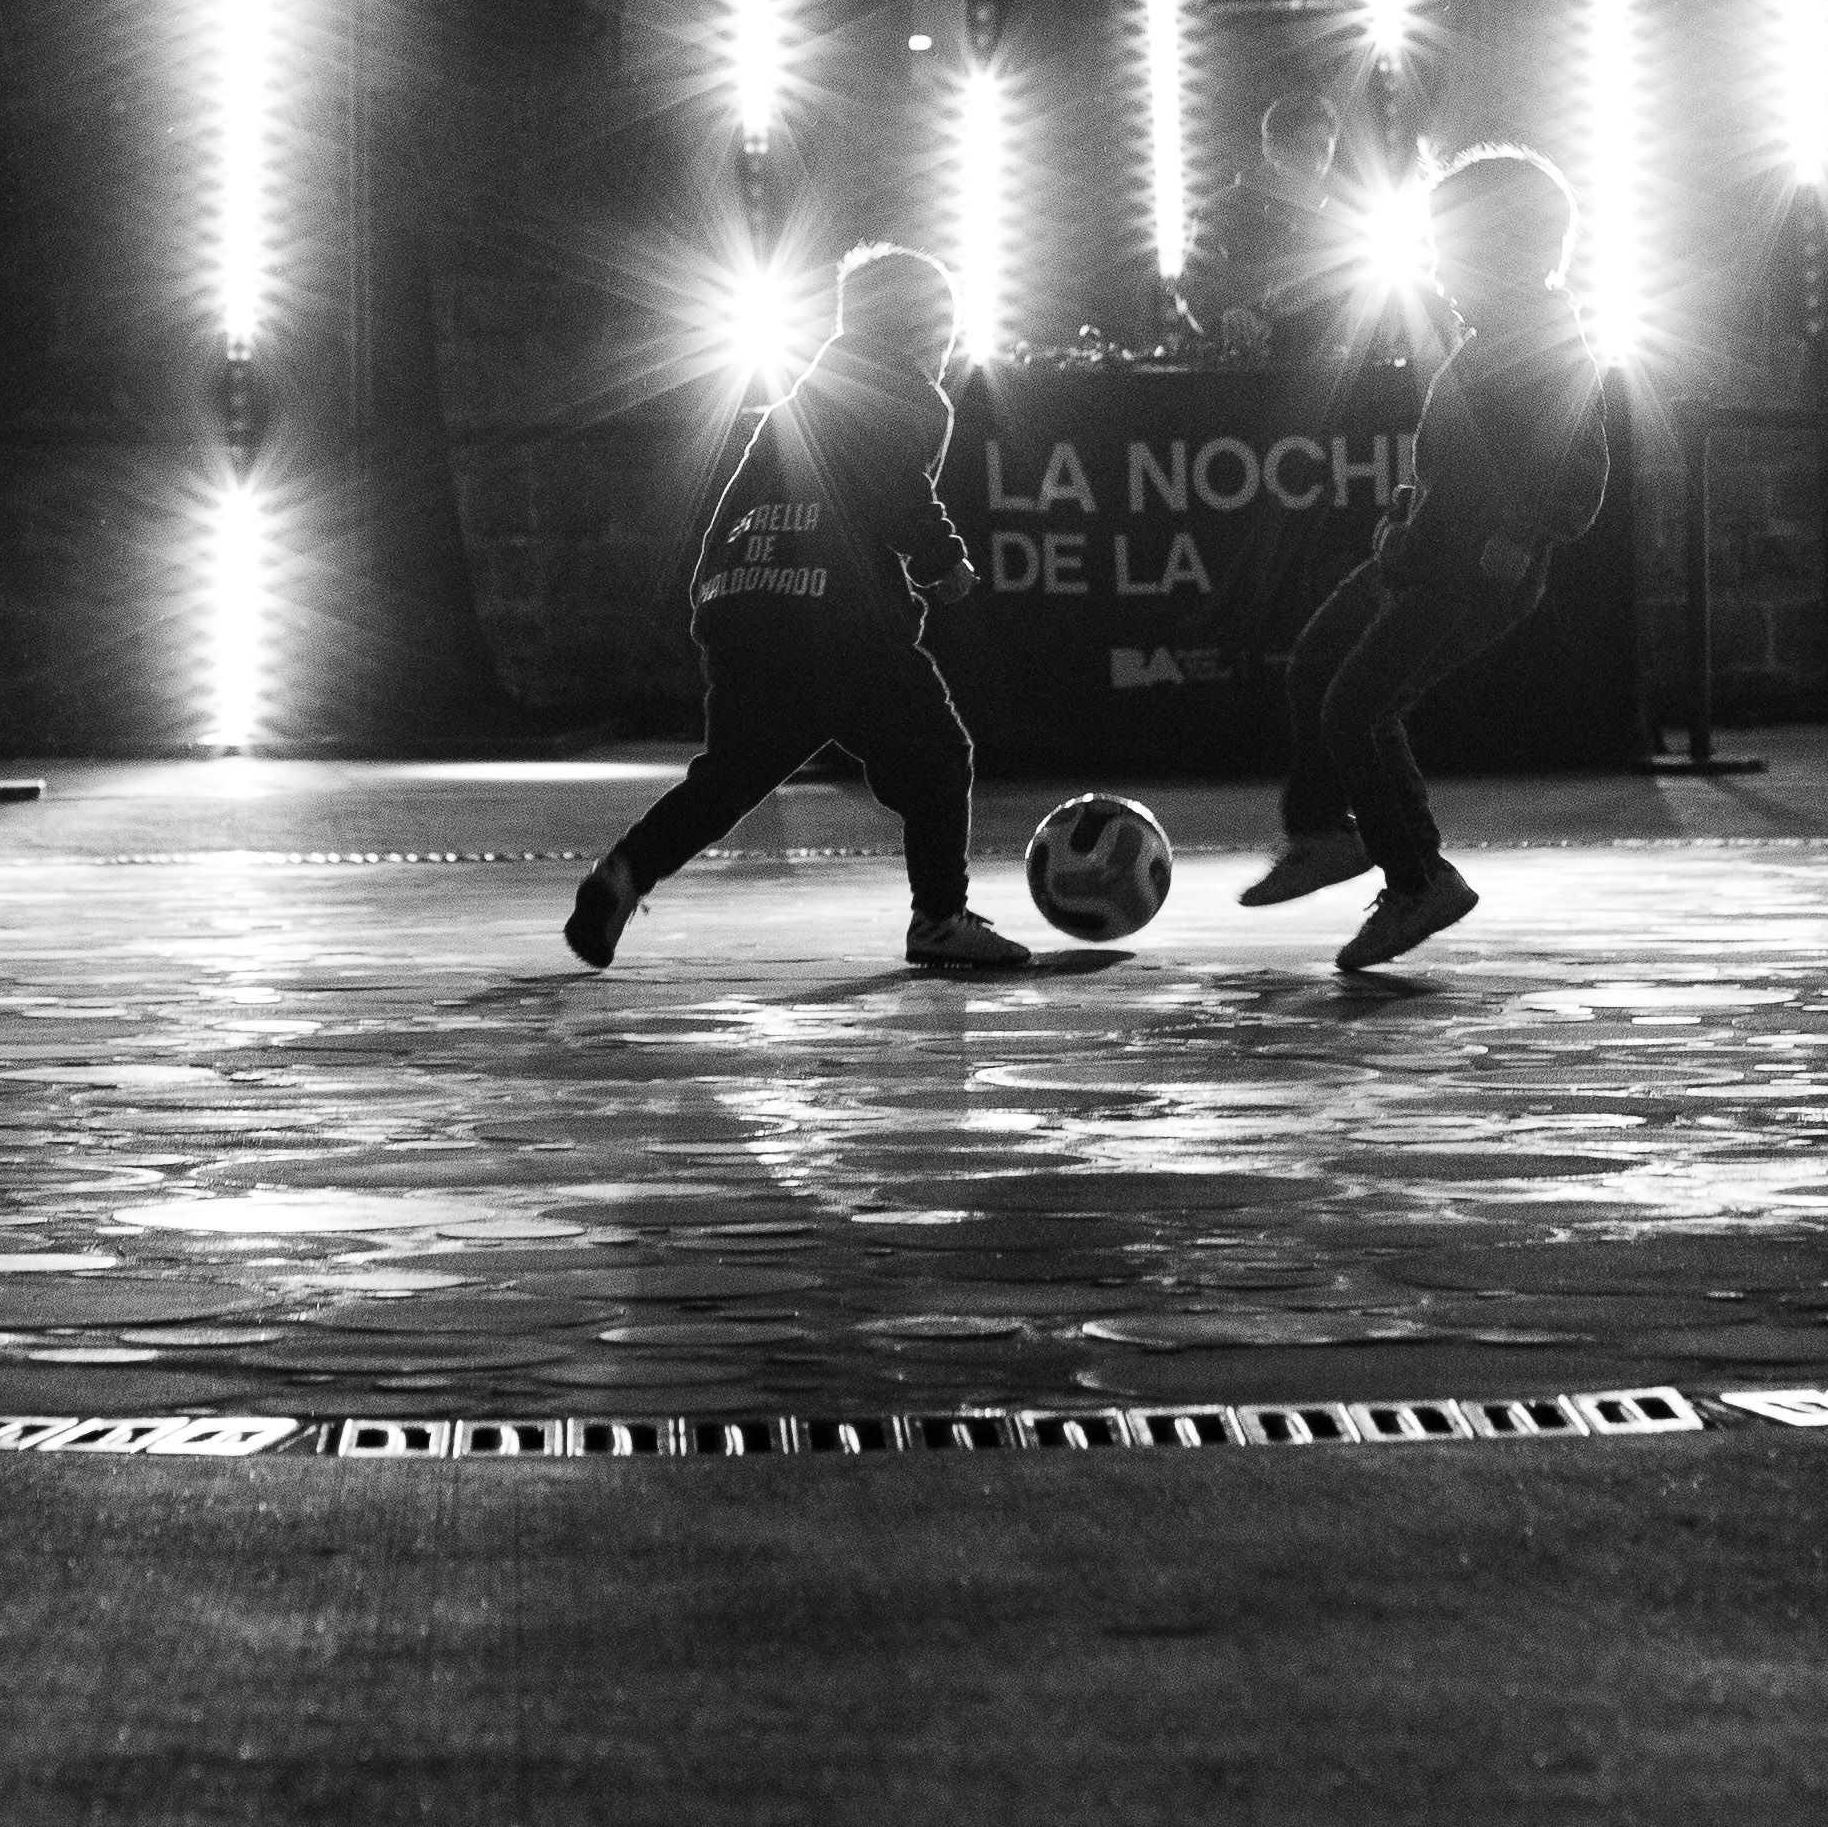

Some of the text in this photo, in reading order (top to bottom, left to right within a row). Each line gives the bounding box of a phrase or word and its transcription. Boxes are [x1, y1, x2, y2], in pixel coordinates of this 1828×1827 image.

[984, 438, 1097, 514] LA
[990, 531, 1213, 595] DE LA
[1109, 646, 1185, 689] BA
